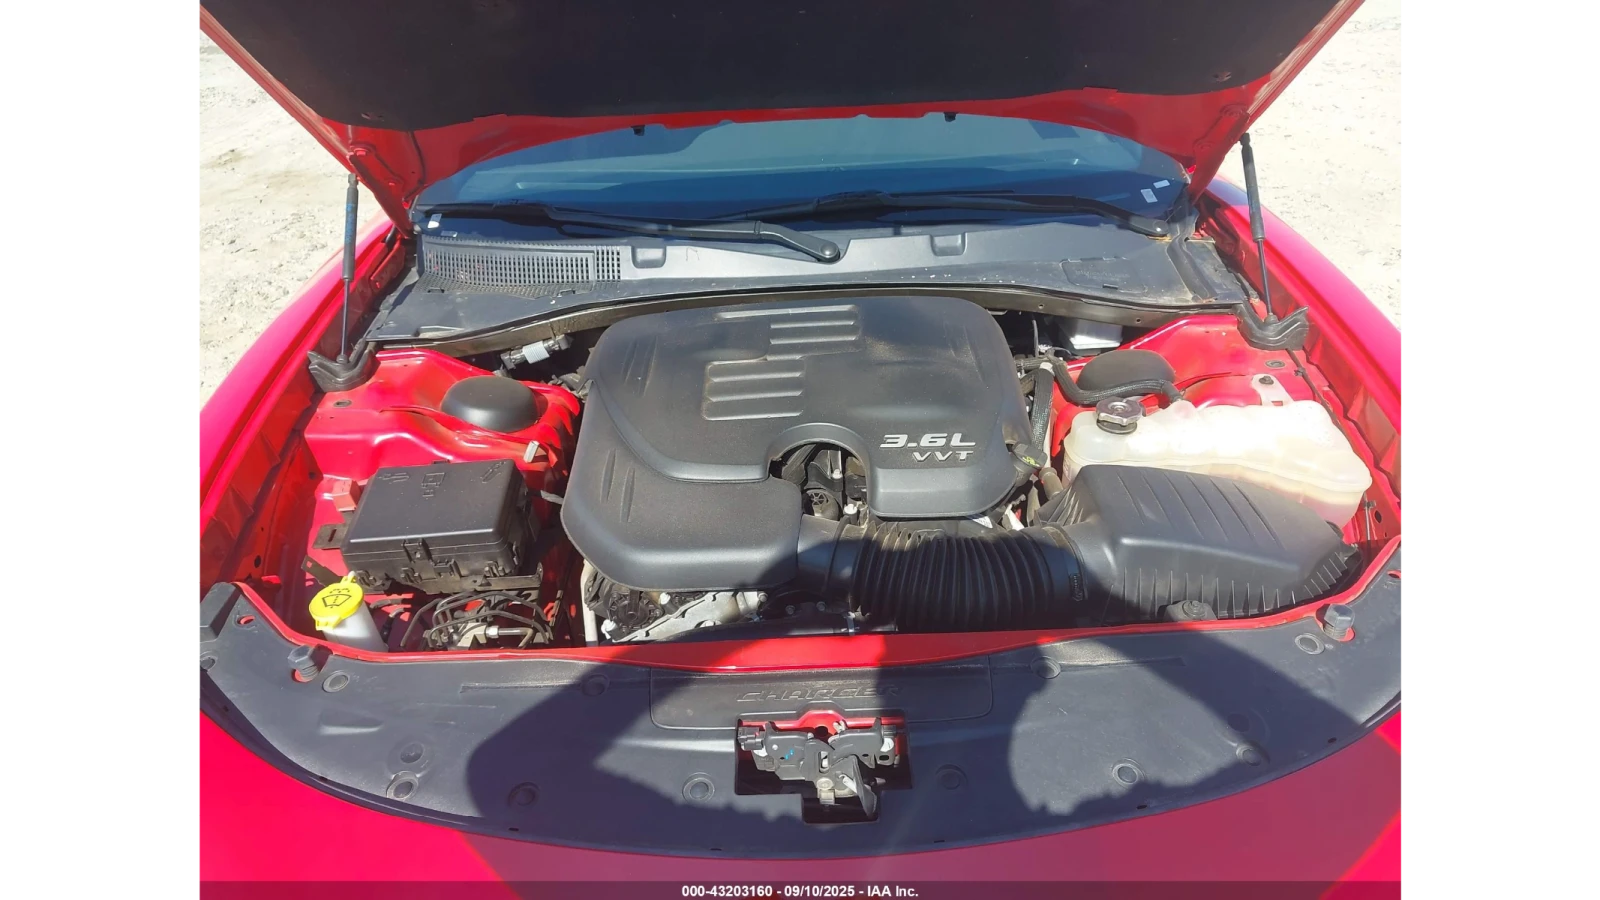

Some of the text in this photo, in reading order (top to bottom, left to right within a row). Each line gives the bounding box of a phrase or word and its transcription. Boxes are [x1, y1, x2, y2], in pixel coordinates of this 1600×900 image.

[879, 432, 976, 448] 3.6L
[912, 450, 974, 462] VVT
[737, 686, 901, 702] CHARGER
